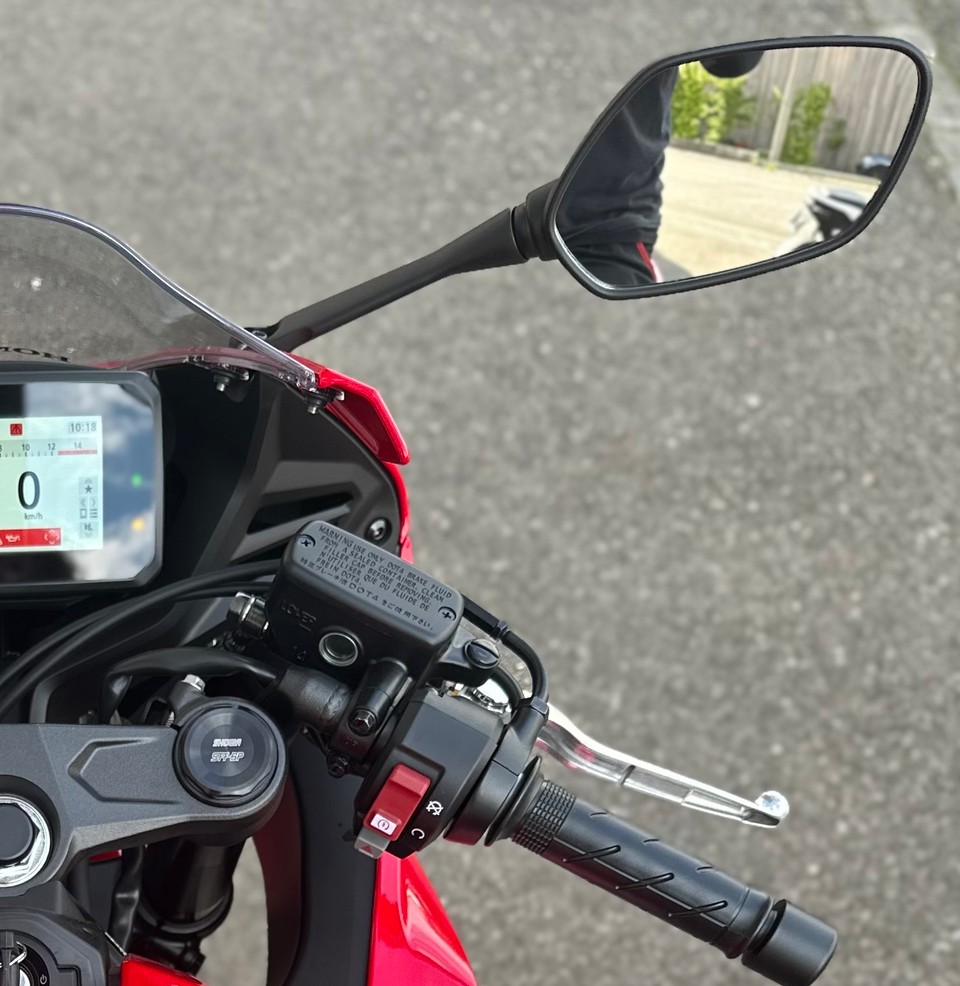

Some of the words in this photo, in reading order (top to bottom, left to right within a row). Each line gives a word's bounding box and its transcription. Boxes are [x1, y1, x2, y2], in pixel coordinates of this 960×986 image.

[71, 423, 96, 432] 10:18
[18, 471, 40, 510] 0
[316, 557, 339, 573] FREIN
[319, 525, 354, 548] WARNING
[353, 544, 366, 555] USE
[367, 551, 384, 564] ONLY
[407, 571, 428, 586] BRAKE
[430, 584, 453, 599] FLUID
[320, 535, 339, 549] FROM
[348, 550, 376, 568] SEALED
[421, 587, 445, 603] CLEAN
[323, 545, 349, 562] FILLER
[351, 559, 366, 570] CAP
[368, 568, 393, 585] BEFORE
[362, 574, 378, 585] QUE
[379, 582, 390, 591] DU
[392, 588, 418, 605] FLUIDE
[419, 602, 430, 612] DE
